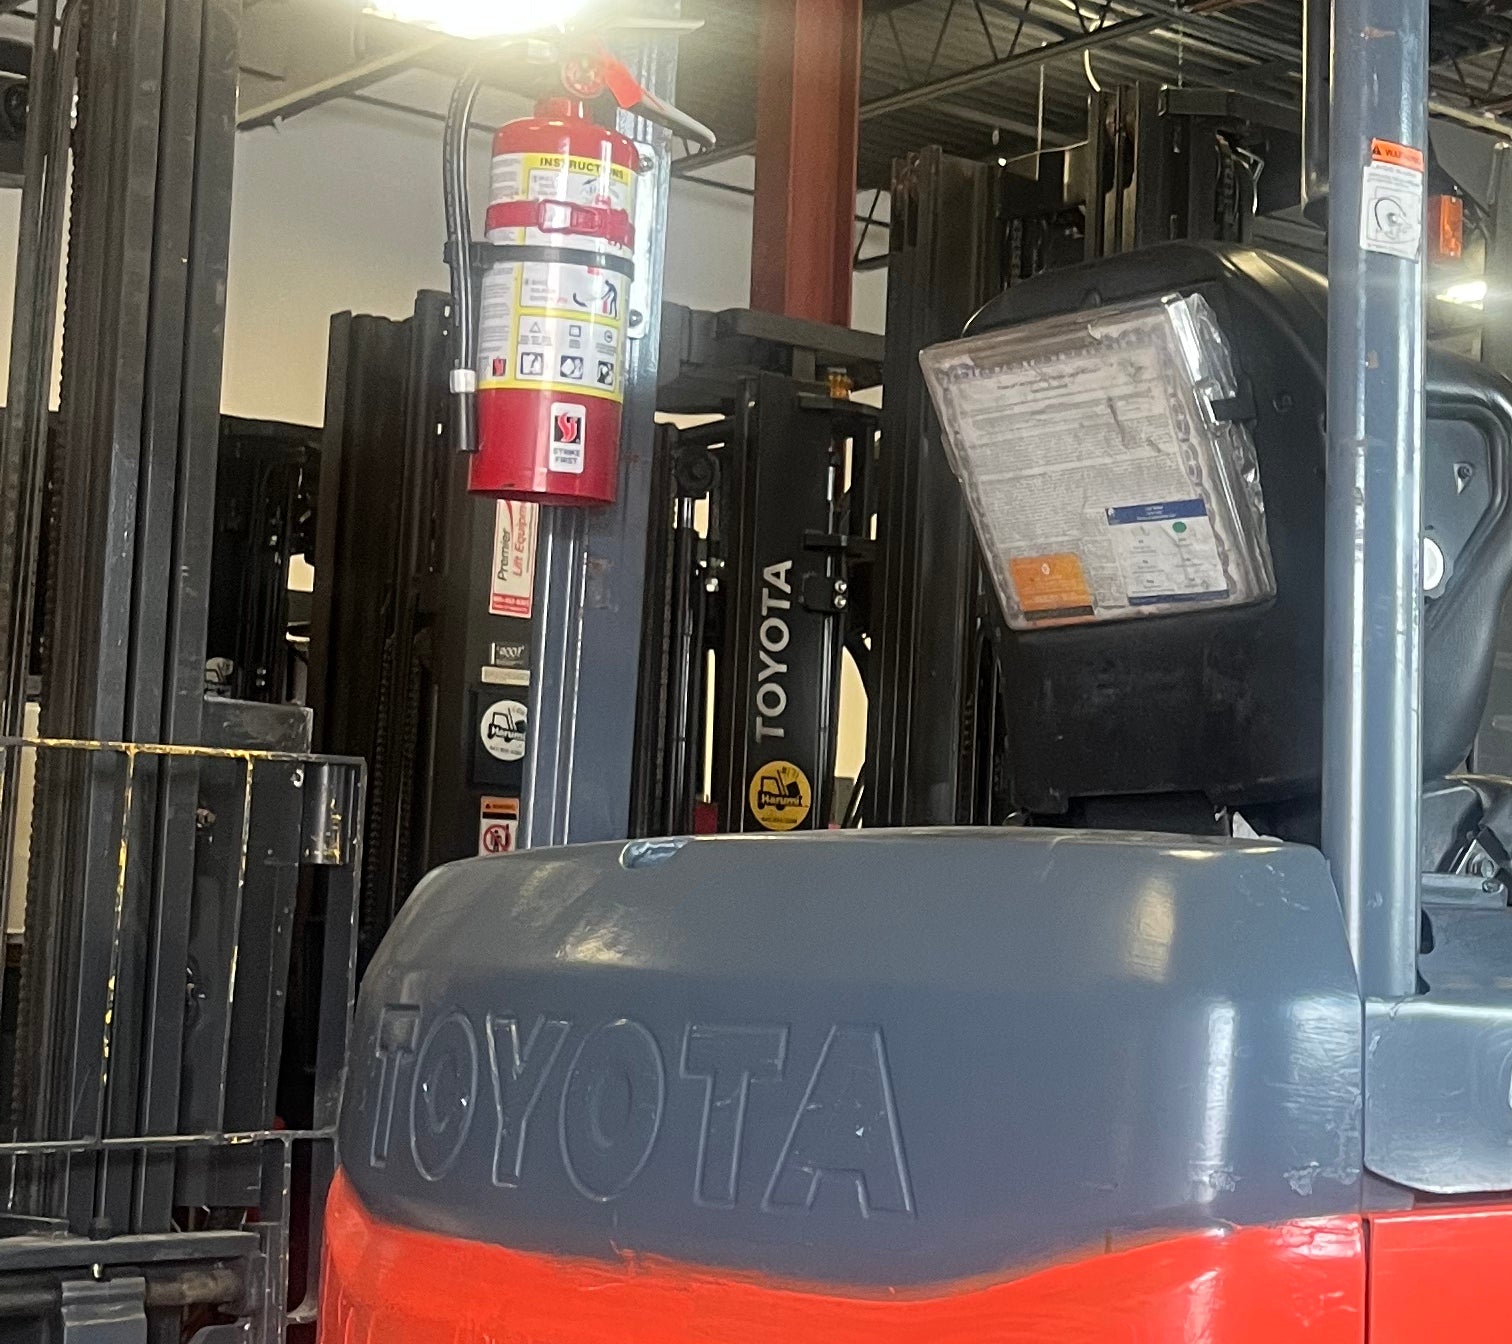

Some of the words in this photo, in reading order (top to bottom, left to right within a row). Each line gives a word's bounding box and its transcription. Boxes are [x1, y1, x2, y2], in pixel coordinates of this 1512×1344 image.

[497, 528, 511, 581] Premier
[755, 559, 793, 744] TOYOTA
[369, 1003, 916, 1219] TOYOTA
